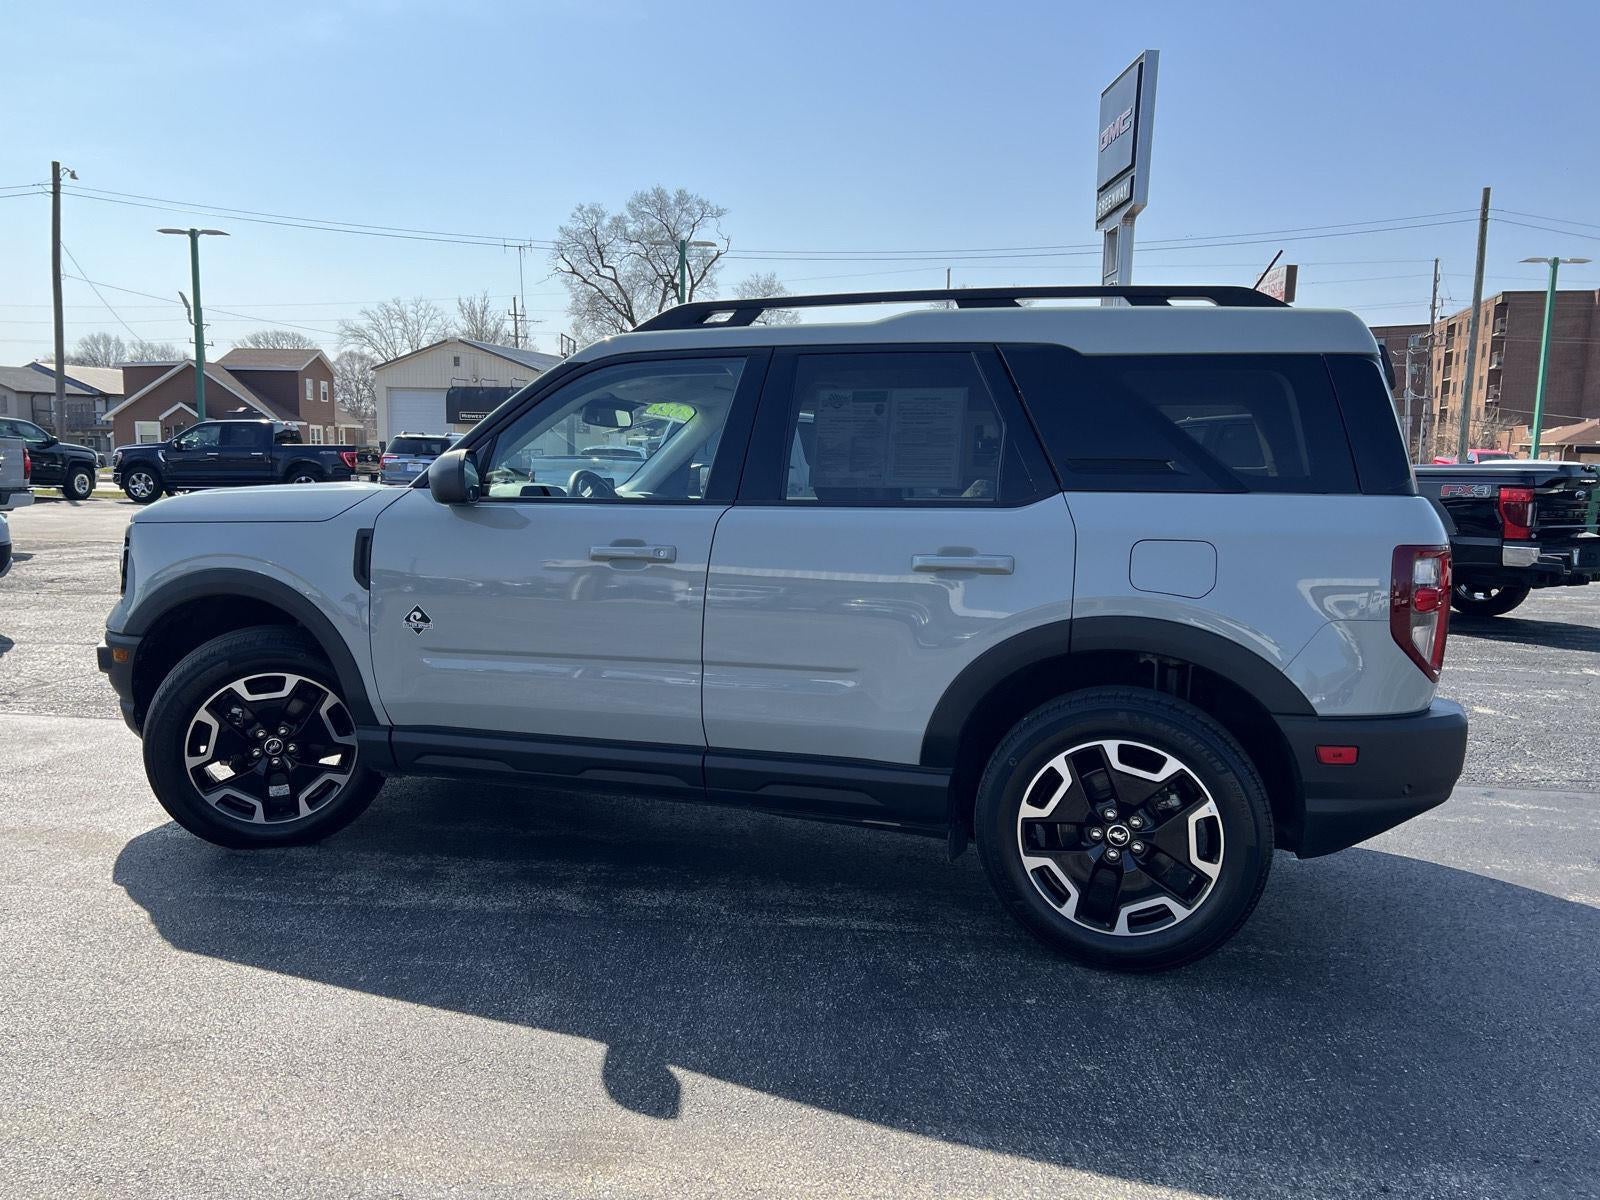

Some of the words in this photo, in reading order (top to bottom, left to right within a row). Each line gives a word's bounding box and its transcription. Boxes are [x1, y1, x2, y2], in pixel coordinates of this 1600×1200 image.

[1100, 106, 1132, 152] GMC
[1098, 182, 1128, 216] GREENWAY
[1441, 484, 1491, 498] FX4
